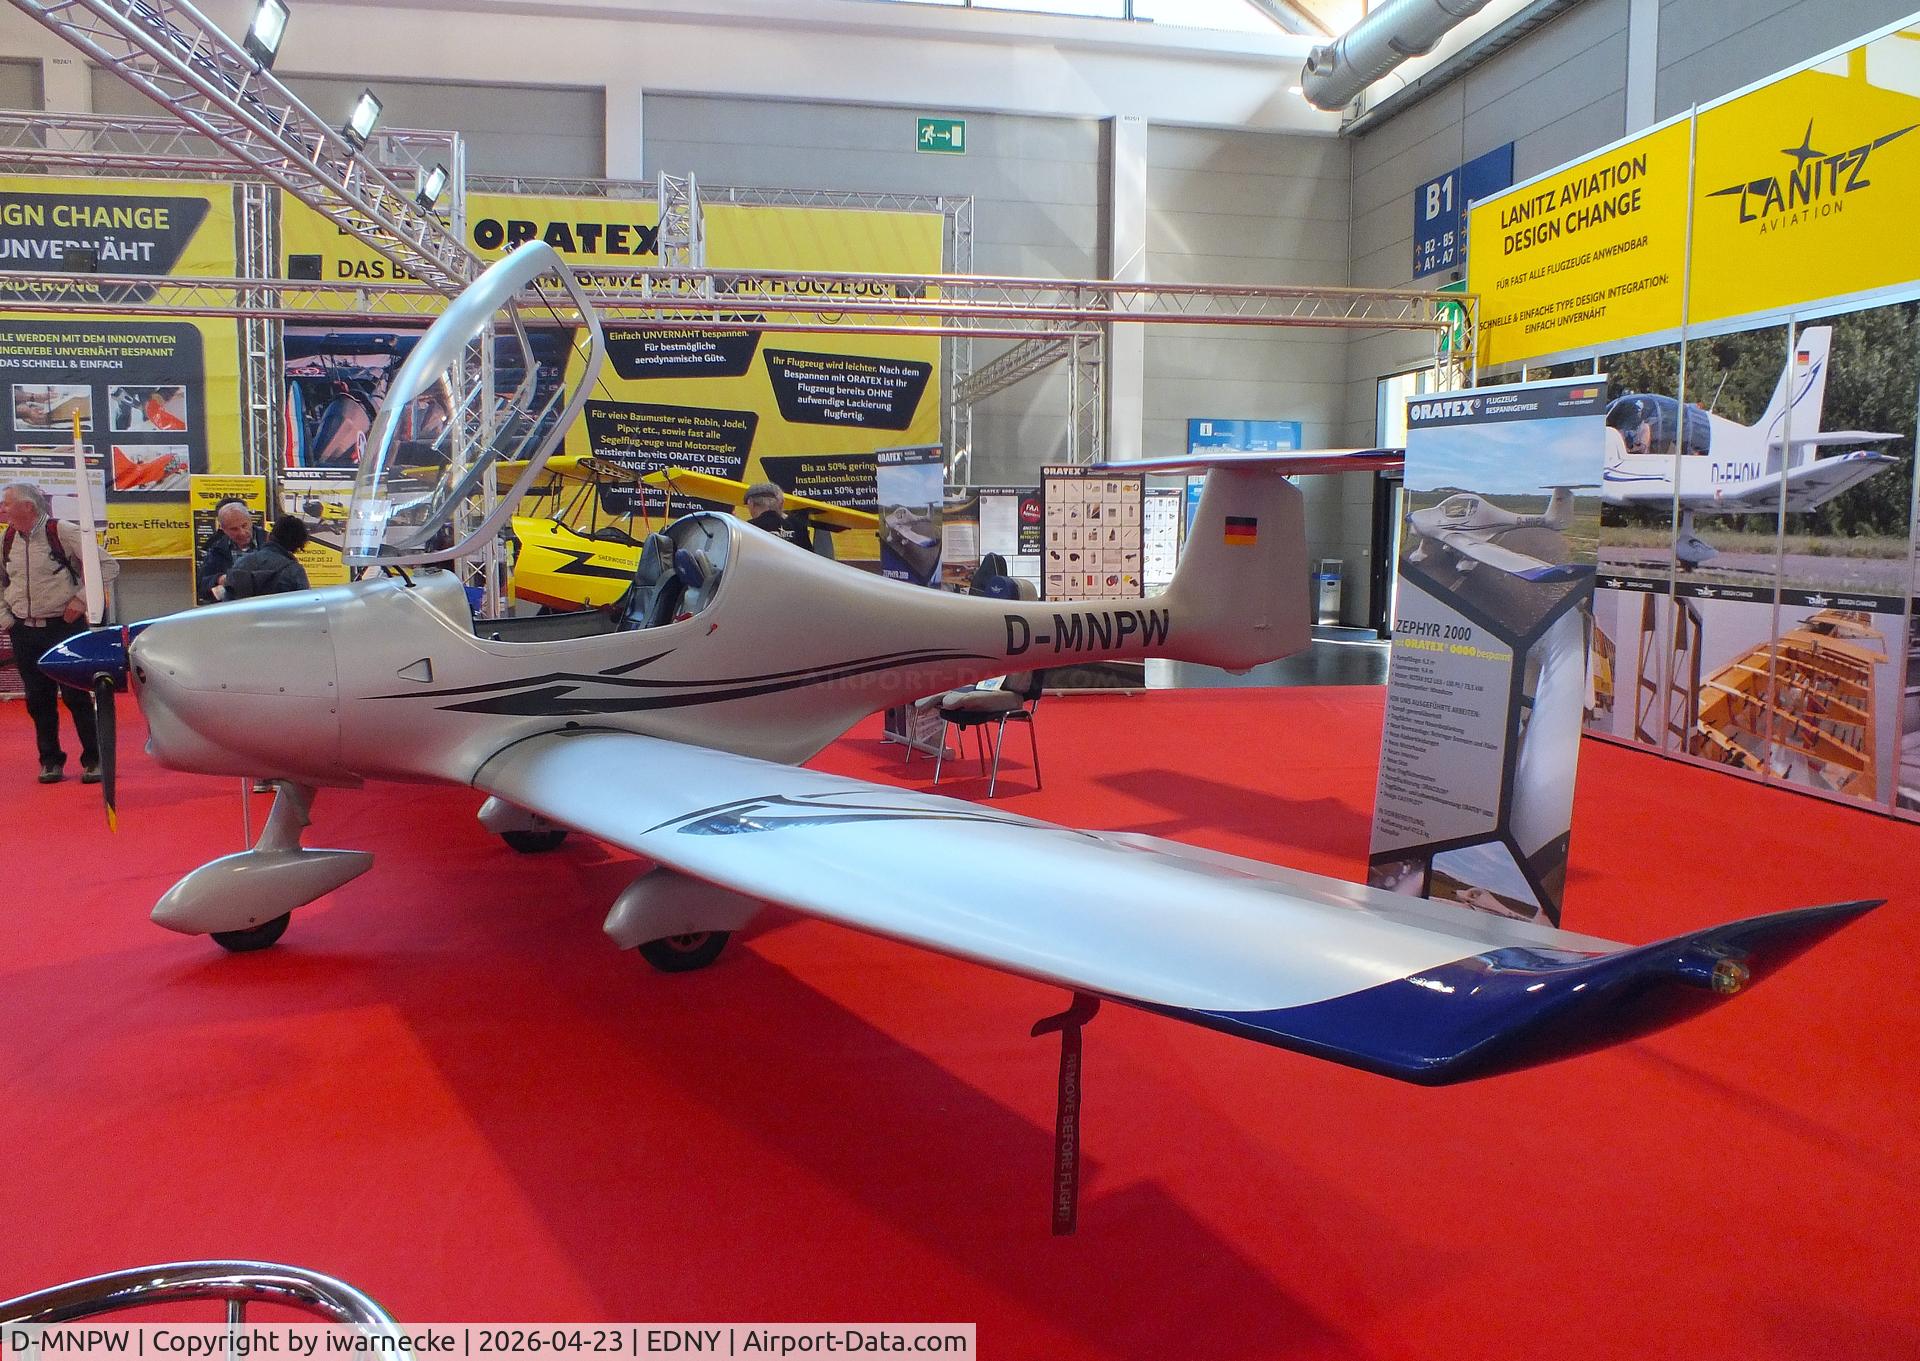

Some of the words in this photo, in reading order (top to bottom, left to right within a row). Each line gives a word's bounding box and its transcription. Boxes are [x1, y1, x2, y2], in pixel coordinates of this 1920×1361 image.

[1501, 190, 1556, 229] LANITZ
[1559, 153, 1647, 207] AVIATION
[1739, 143, 1872, 225] LANITZ
[1425, 175, 1453, 221] B1
[52, 205, 170, 230] CHANGE
[1504, 220, 1561, 255] DESIGN
[1565, 188, 1642, 234] CHANGE
[1759, 200, 1844, 235] AVIATION
[473, 218, 660, 256] ORATEX
[1424, 238, 1436, 255] B2
[1442, 231, 1454, 247] B5
[1424, 255, 1435, 271] A1
[1442, 248, 1454, 265] A7
[1496, 276, 1510, 291] FÜR
[1511, 272, 1527, 286] FAST
[1529, 267, 1546, 281] ALLE
[1547, 252, 1592, 276] FLUGZEUGE
[1592, 235, 1648, 262] ANWENDBAR
[338, 260, 385, 279] DAS
[1479, 314, 1513, 332] SCHNELLE
[1519, 303, 1554, 321] EINFACHE
[1556, 298, 1574, 313] TYPE
[1575, 290, 1606, 308] DESIGN
[1607, 274, 1669, 300] INTEGRATION:
[1525, 317, 1556, 335] EINFACH
[1557, 305, 1607, 328] UNVERNÄHT
[16, 333, 60, 343] WERDEN
[62, 334, 80, 343] MIT
[83, 334, 106, 344] DEM
[108, 334, 176, 344] INNOVATIVEN
[609, 332, 641, 341] Einfach
[702, 330, 750, 339] bespannen.
[55, 345, 119, 356] UNVERNÄHT
[121, 347, 174, 357] BESPANNT
[644, 343, 659, 352] Für
[660, 342, 716, 352] bestmögliche
[22, 359, 69, 368] SCHNELL
[70, 360, 78, 369] &
[80, 360, 123, 369] EINFACH
[635, 355, 703, 365] aerodynamische
[704, 353, 727, 363] Güte.
[773, 356, 785, 365] Ihr
[786, 357, 824, 370] Flugzeug
[825, 361, 843, 370] wird
[845, 362, 877, 373] leichter.
[879, 365, 900, 375] Nach
[902, 367, 919, 376] dem
[784, 369, 830, 382] Bespannen
[831, 373, 845, 382] mit
[847, 374, 882, 385] ORATEX
[883, 376, 894, 386] ist
[896, 378, 907, 388] Ihr
[797, 383, 835, 395] Flugzeug
[836, 386, 865, 396] bereits
[867, 388, 893, 398] OHNE
[797, 396, 845, 407] aufwendige
[846, 398, 892, 412] Lackierung
[1485, 402, 1538, 415] BESPANNGEWEBE
[1486, 395, 1518, 405] FLUGZEUG
[591, 409, 607, 419] Für
[630, 413, 675, 424] Baumuster
[677, 416, 692, 425] wie
[694, 417, 720, 428] Robin,
[722, 419, 747, 430] Jodel,
[824, 408, 864, 421] flugfertig.
[643, 426, 660, 436] etc.,
[662, 427, 686, 437] sowie
[688, 428, 704, 438] fast
[705, 430, 721, 439] alle
[667, 438, 683, 448] und
[684, 442, 736, 454] Motorsegler
[594, 448, 636, 458] existieren
[669, 452, 706, 462] ORATEX
[707, 454, 741, 465] DESIGN
[691, 466, 728, 476] ORATEX
[801, 463, 814, 472] Bis
[827, 462, 848, 472] 50%
[795, 474, 873, 484] Installationskosten
[792, 488, 807, 496] des
[808, 487, 821, 496] bis
[834, 486, 854, 494] 50%
[107, 519, 190, 530] ortex-Effektes
[1004, 608, 1170, 656] D-MNPW
[1395, 619, 1440, 638] ZEPHYR
[1443, 624, 1472, 641] 2000
[1061, 1115, 1075, 1170] BEFORE
